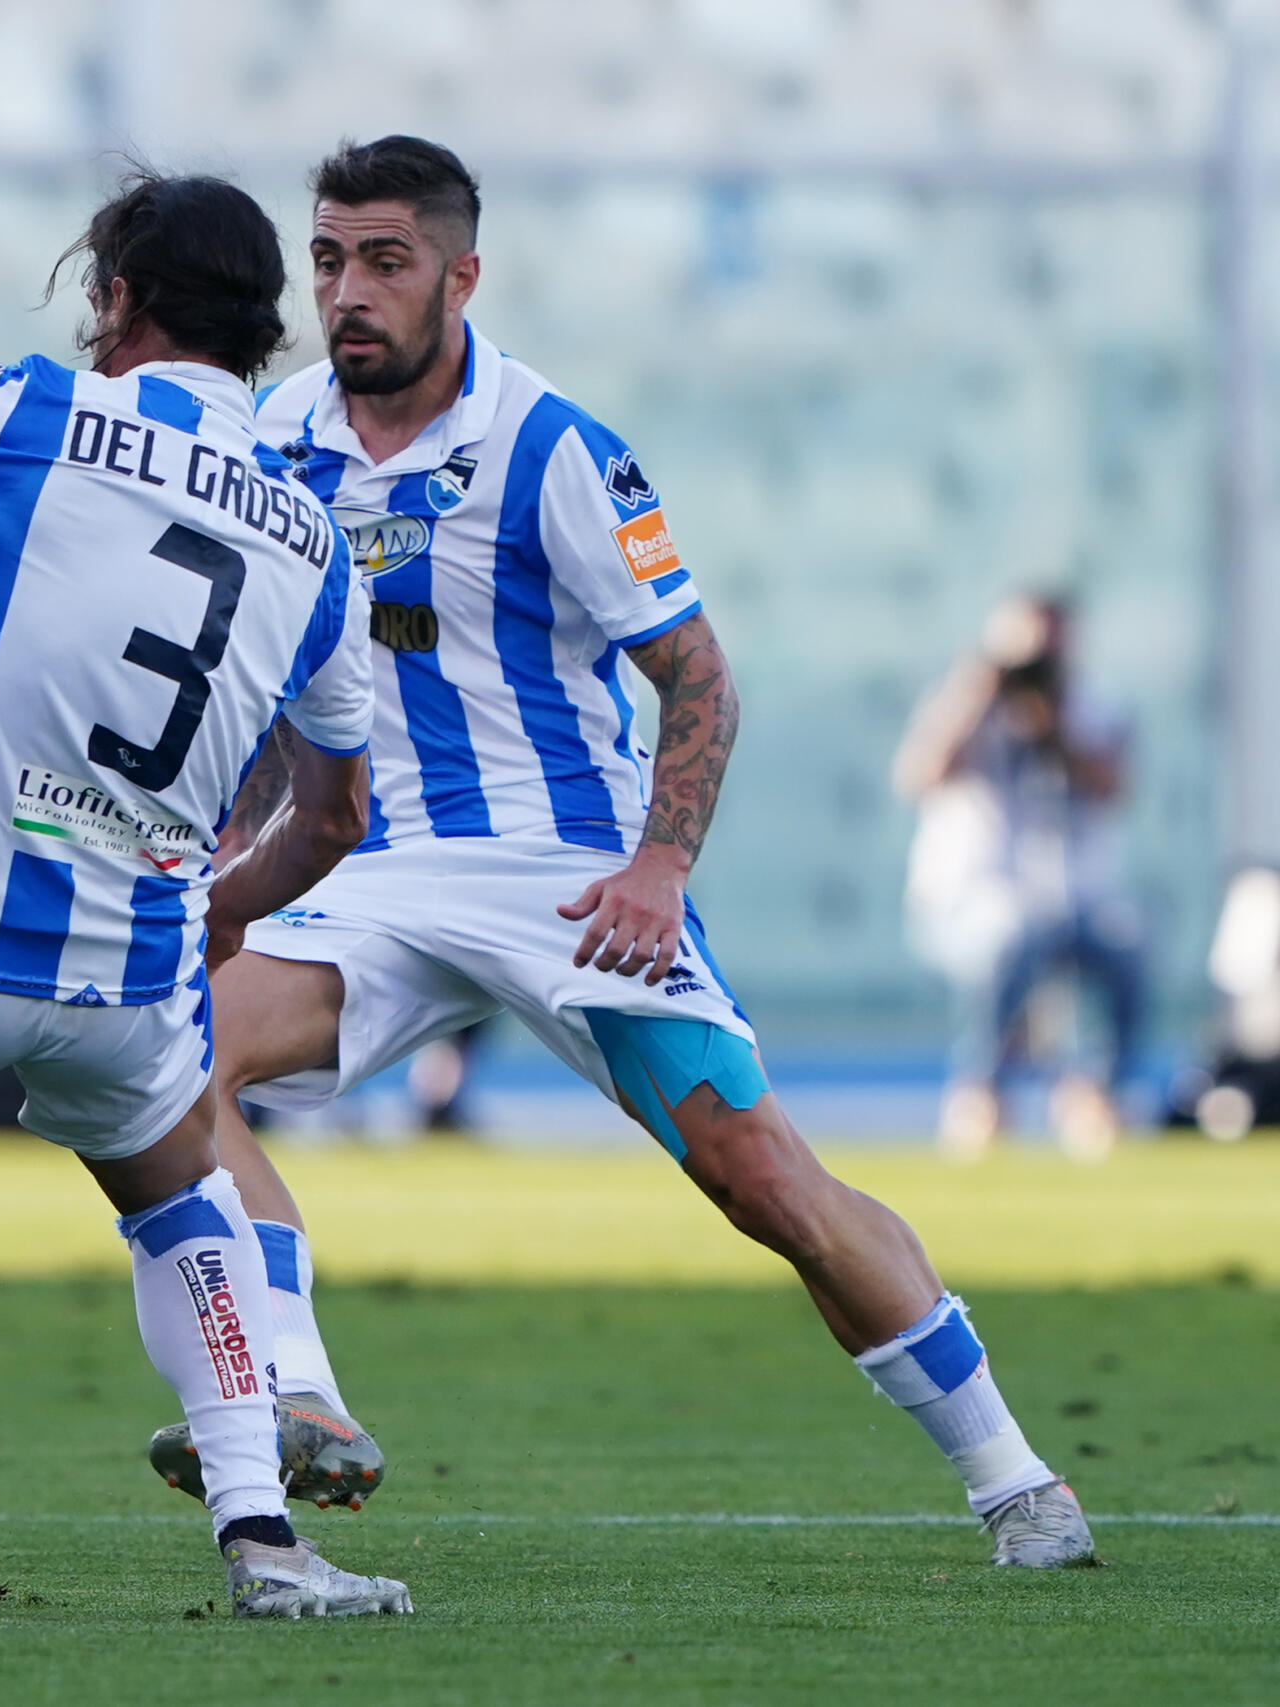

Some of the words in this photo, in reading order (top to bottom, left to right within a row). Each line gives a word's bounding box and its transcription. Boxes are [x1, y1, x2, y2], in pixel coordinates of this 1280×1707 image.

[68, 409, 167, 487] DEL
[186, 443, 331, 572] GROSSO
[87, 521, 248, 793] 3
[14, 800, 129, 838] Microbiology
[18, 768, 194, 843] Liofilchem
